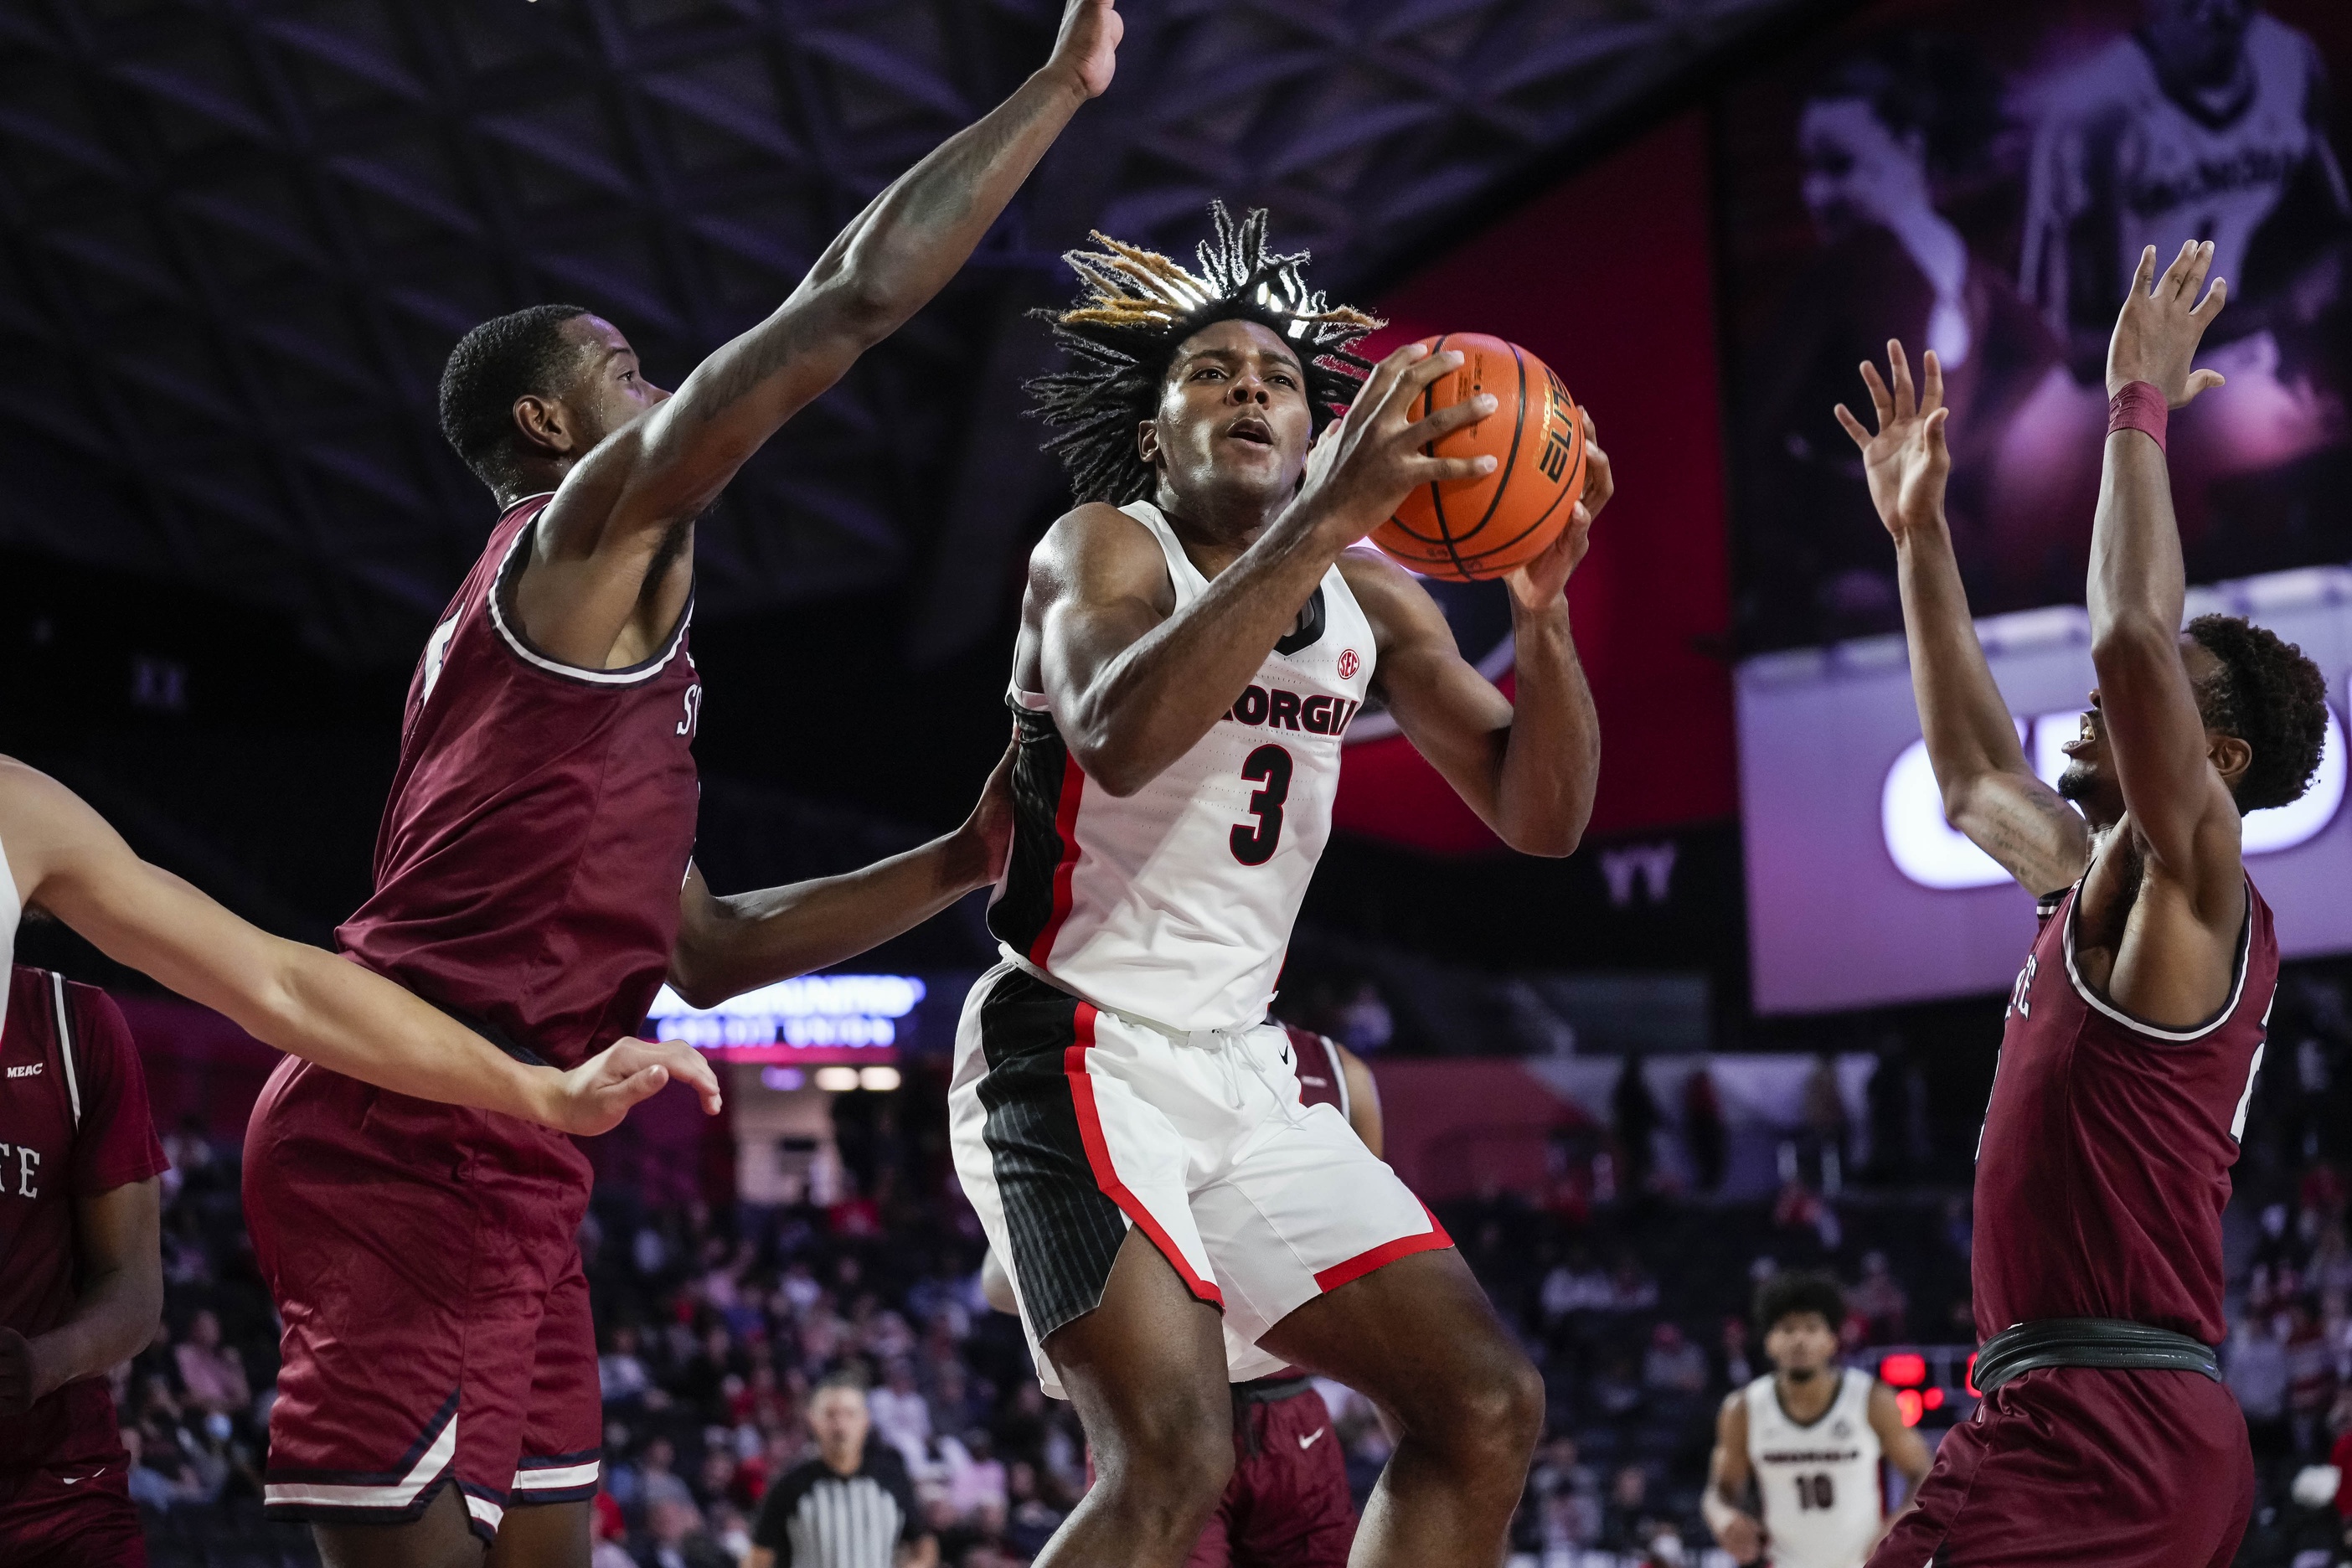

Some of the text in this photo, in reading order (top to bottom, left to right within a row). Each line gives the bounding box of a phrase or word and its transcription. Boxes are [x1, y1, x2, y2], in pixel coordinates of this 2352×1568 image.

[1339, 649, 1359, 678] SEC
[1221, 684, 1358, 735] ORGI
[1230, 744, 1293, 866] 3
[7, 1063, 43, 1078] MEAC
[1796, 1473, 1834, 1511] 10
